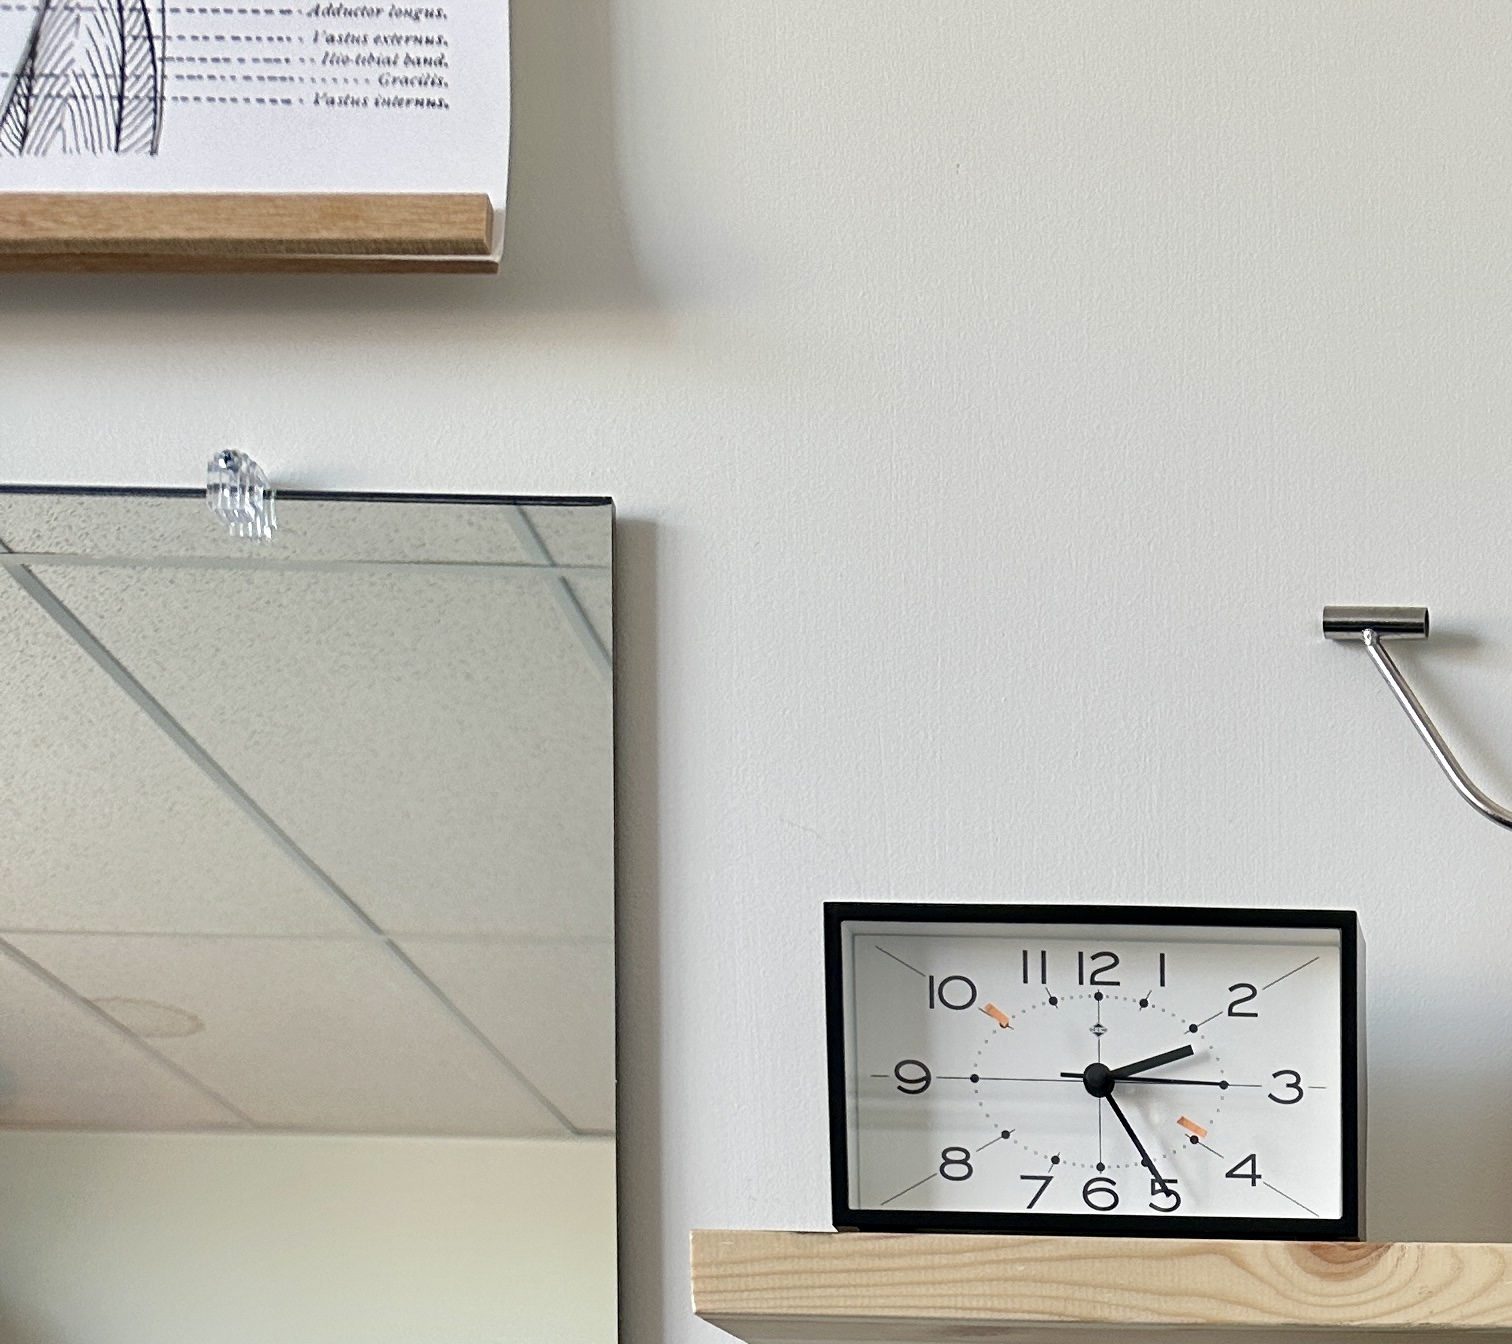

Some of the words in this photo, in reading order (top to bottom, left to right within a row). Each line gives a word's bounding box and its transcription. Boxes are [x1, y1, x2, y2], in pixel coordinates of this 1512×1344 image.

[306, 3, 384, 18] Adductor
[388, 4, 448, 21] longus.
[313, 29, 368, 46] Vastus
[373, 32, 448, 47] externus.
[403, 52, 449, 68] band.
[378, 72, 449, 88] Gracilis.
[313, 92, 369, 108] Vastus
[374, 94, 449, 110] internus.
[1022, 950, 1047, 984] 11
[1079, 951, 1120, 986] 12
[1160, 953, 1165, 987] 1
[929, 975, 977, 1010] 10
[1228, 983, 1258, 1018] 2
[894, 1059, 932, 1095] 9
[1269, 1070, 1304, 1104] 3
[939, 1147, 973, 1181] 8
[1225, 1153, 1262, 1187] 4
[1020, 1175, 1054, 1209] 7
[1082, 1177, 1119, 1212] 6
[1150, 1179, 1181, 1212] 5
